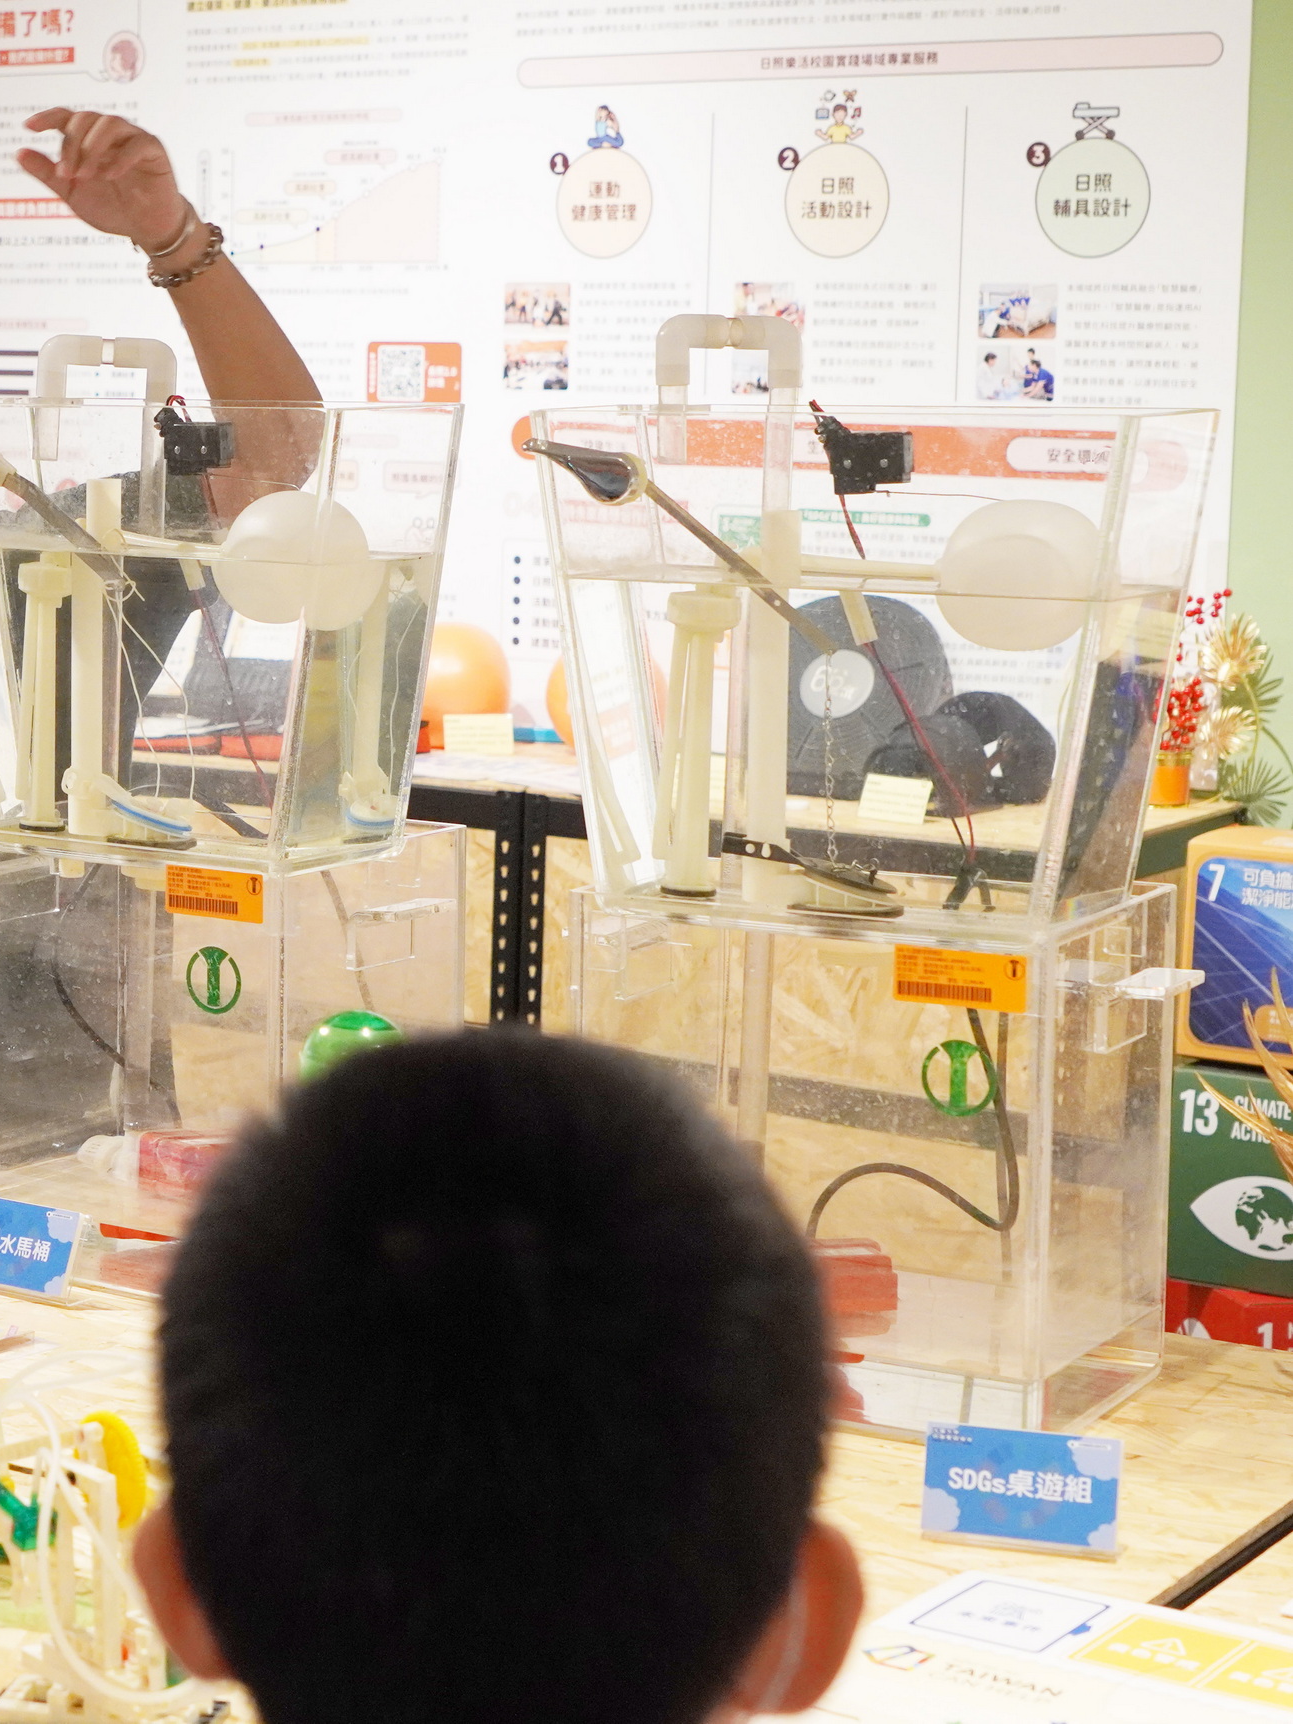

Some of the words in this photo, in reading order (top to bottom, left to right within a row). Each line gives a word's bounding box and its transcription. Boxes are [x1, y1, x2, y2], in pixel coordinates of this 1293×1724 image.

[761, 51, 938, 70] 日照樂活校園實踐場域專業服務
[781, 148, 796, 168] 2
[1032, 145, 1047, 165] 3
[588, 181, 621, 198] 運動
[821, 176, 855, 195] 日照
[1075, 172, 1112, 193] 日照
[570, 203, 637, 221] 健康管理
[801, 200, 872, 219] 活動設計
[1053, 196, 1131, 218] 輔具設計
[1208, 864, 1226, 902] 7
[1241, 887, 1293, 910] 潔淨能
[1179, 1088, 1220, 1137] 13
[948, 1466, 1094, 1504] SDGs桌遊組
